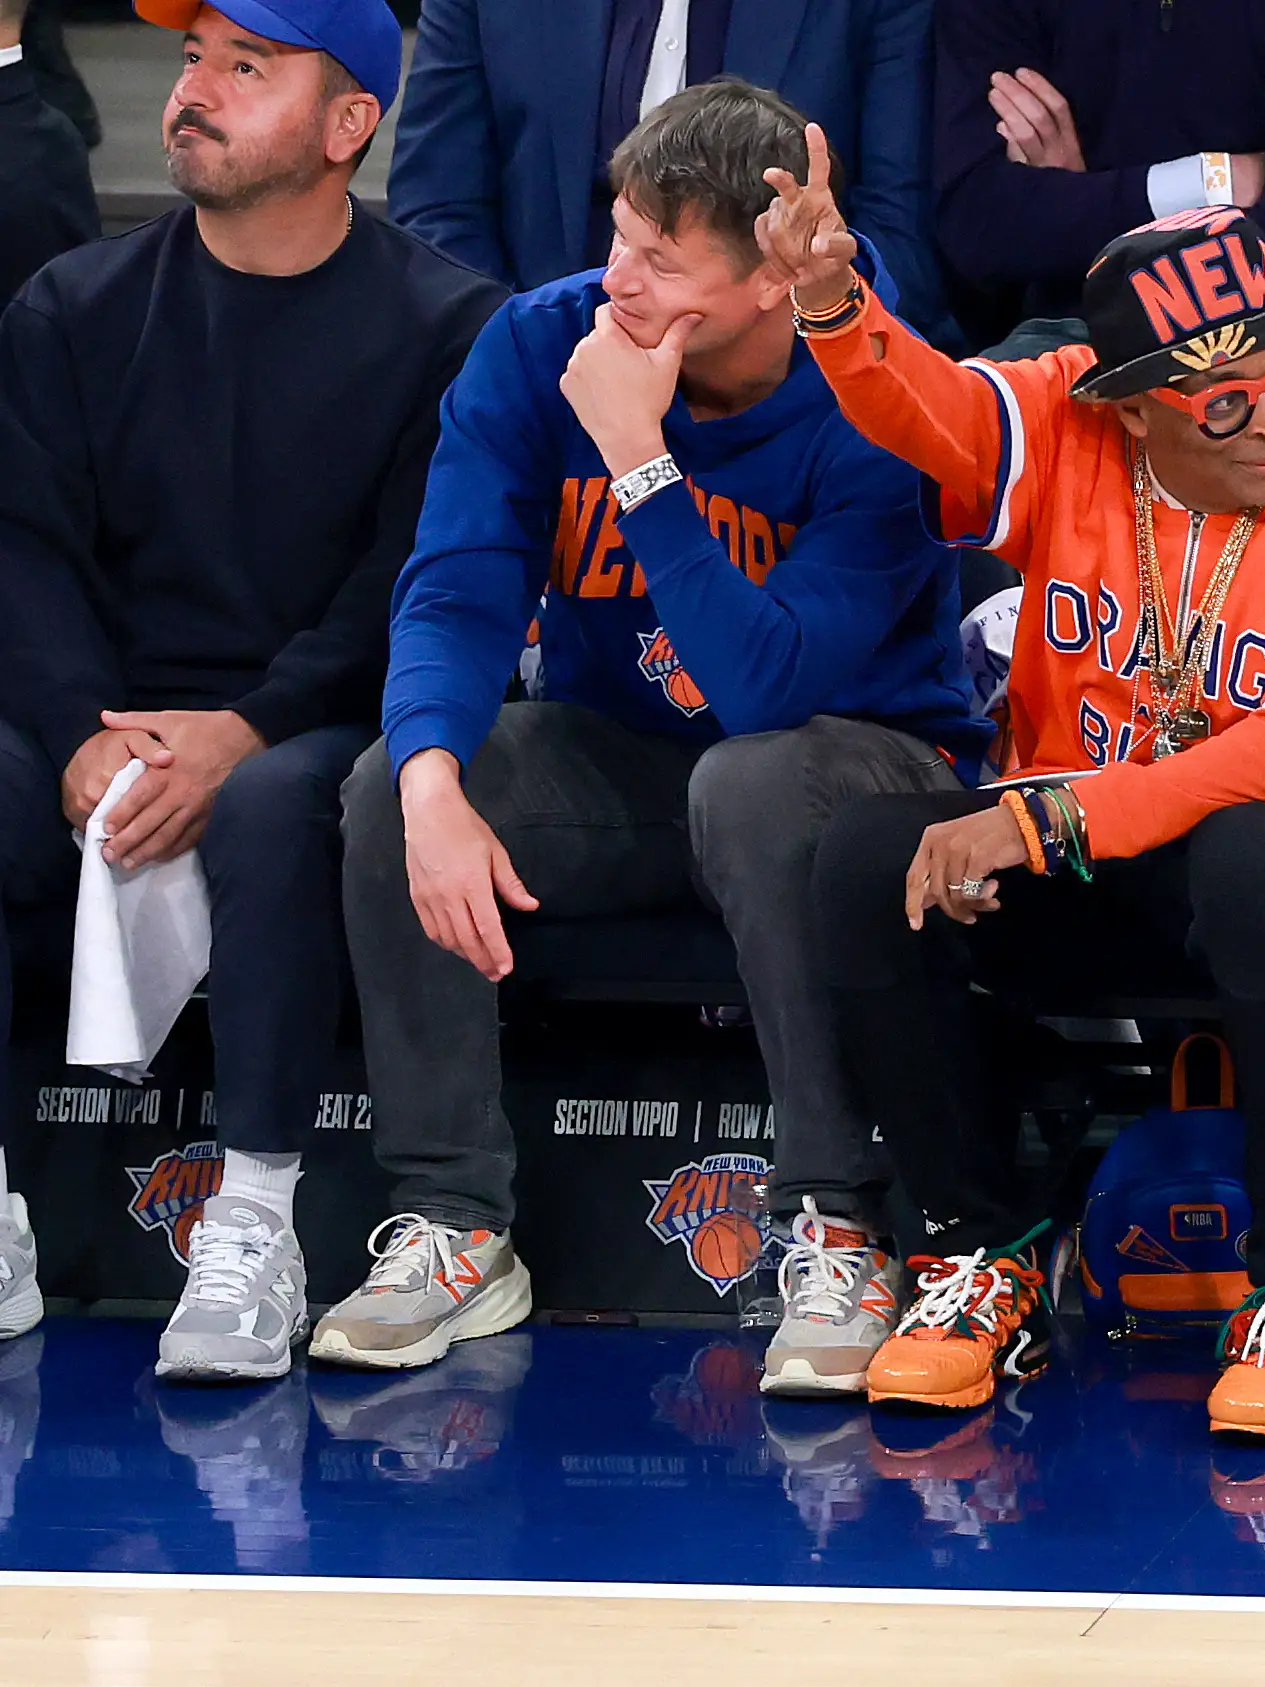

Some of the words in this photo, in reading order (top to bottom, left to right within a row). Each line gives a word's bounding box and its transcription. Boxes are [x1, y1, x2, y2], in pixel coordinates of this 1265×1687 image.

[549, 477, 648, 598] NE
[36, 1086, 111, 1123] SECTION
[554, 1099, 628, 1136] SECTION
[717, 1103, 762, 1139] ROW
[763, 1104, 776, 1140] A
[185, 1143, 214, 1159] NEW
[703, 1157, 732, 1172] NEW
[733, 1157, 766, 1173] YORK
[135, 1156, 225, 1212] KNI
[652, 1169, 777, 1225] KNI
[1191, 1212, 1213, 1226] NBA
